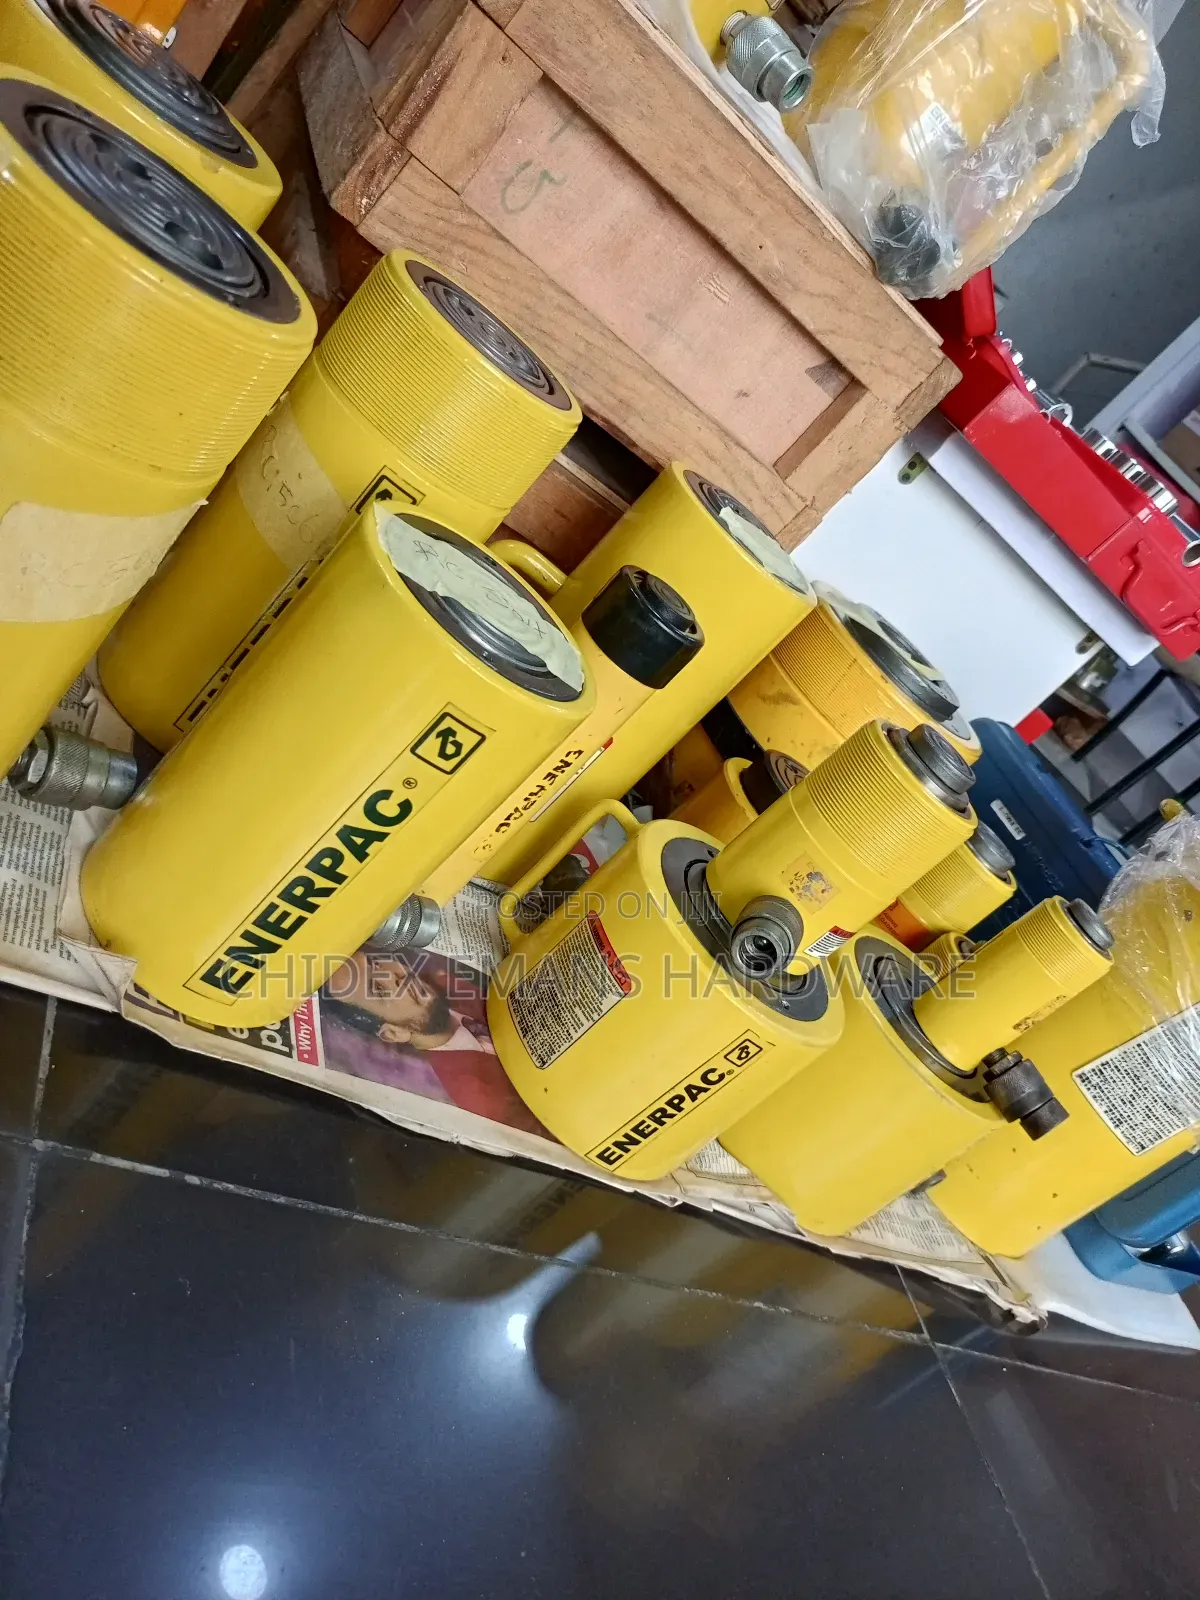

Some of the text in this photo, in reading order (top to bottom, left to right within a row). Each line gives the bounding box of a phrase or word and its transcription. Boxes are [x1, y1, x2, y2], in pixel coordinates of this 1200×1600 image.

[200, 789, 413, 994] ENERPAC
[298, 1023, 313, 1051] Why
[596, 1068, 726, 1166] ENERPAC
